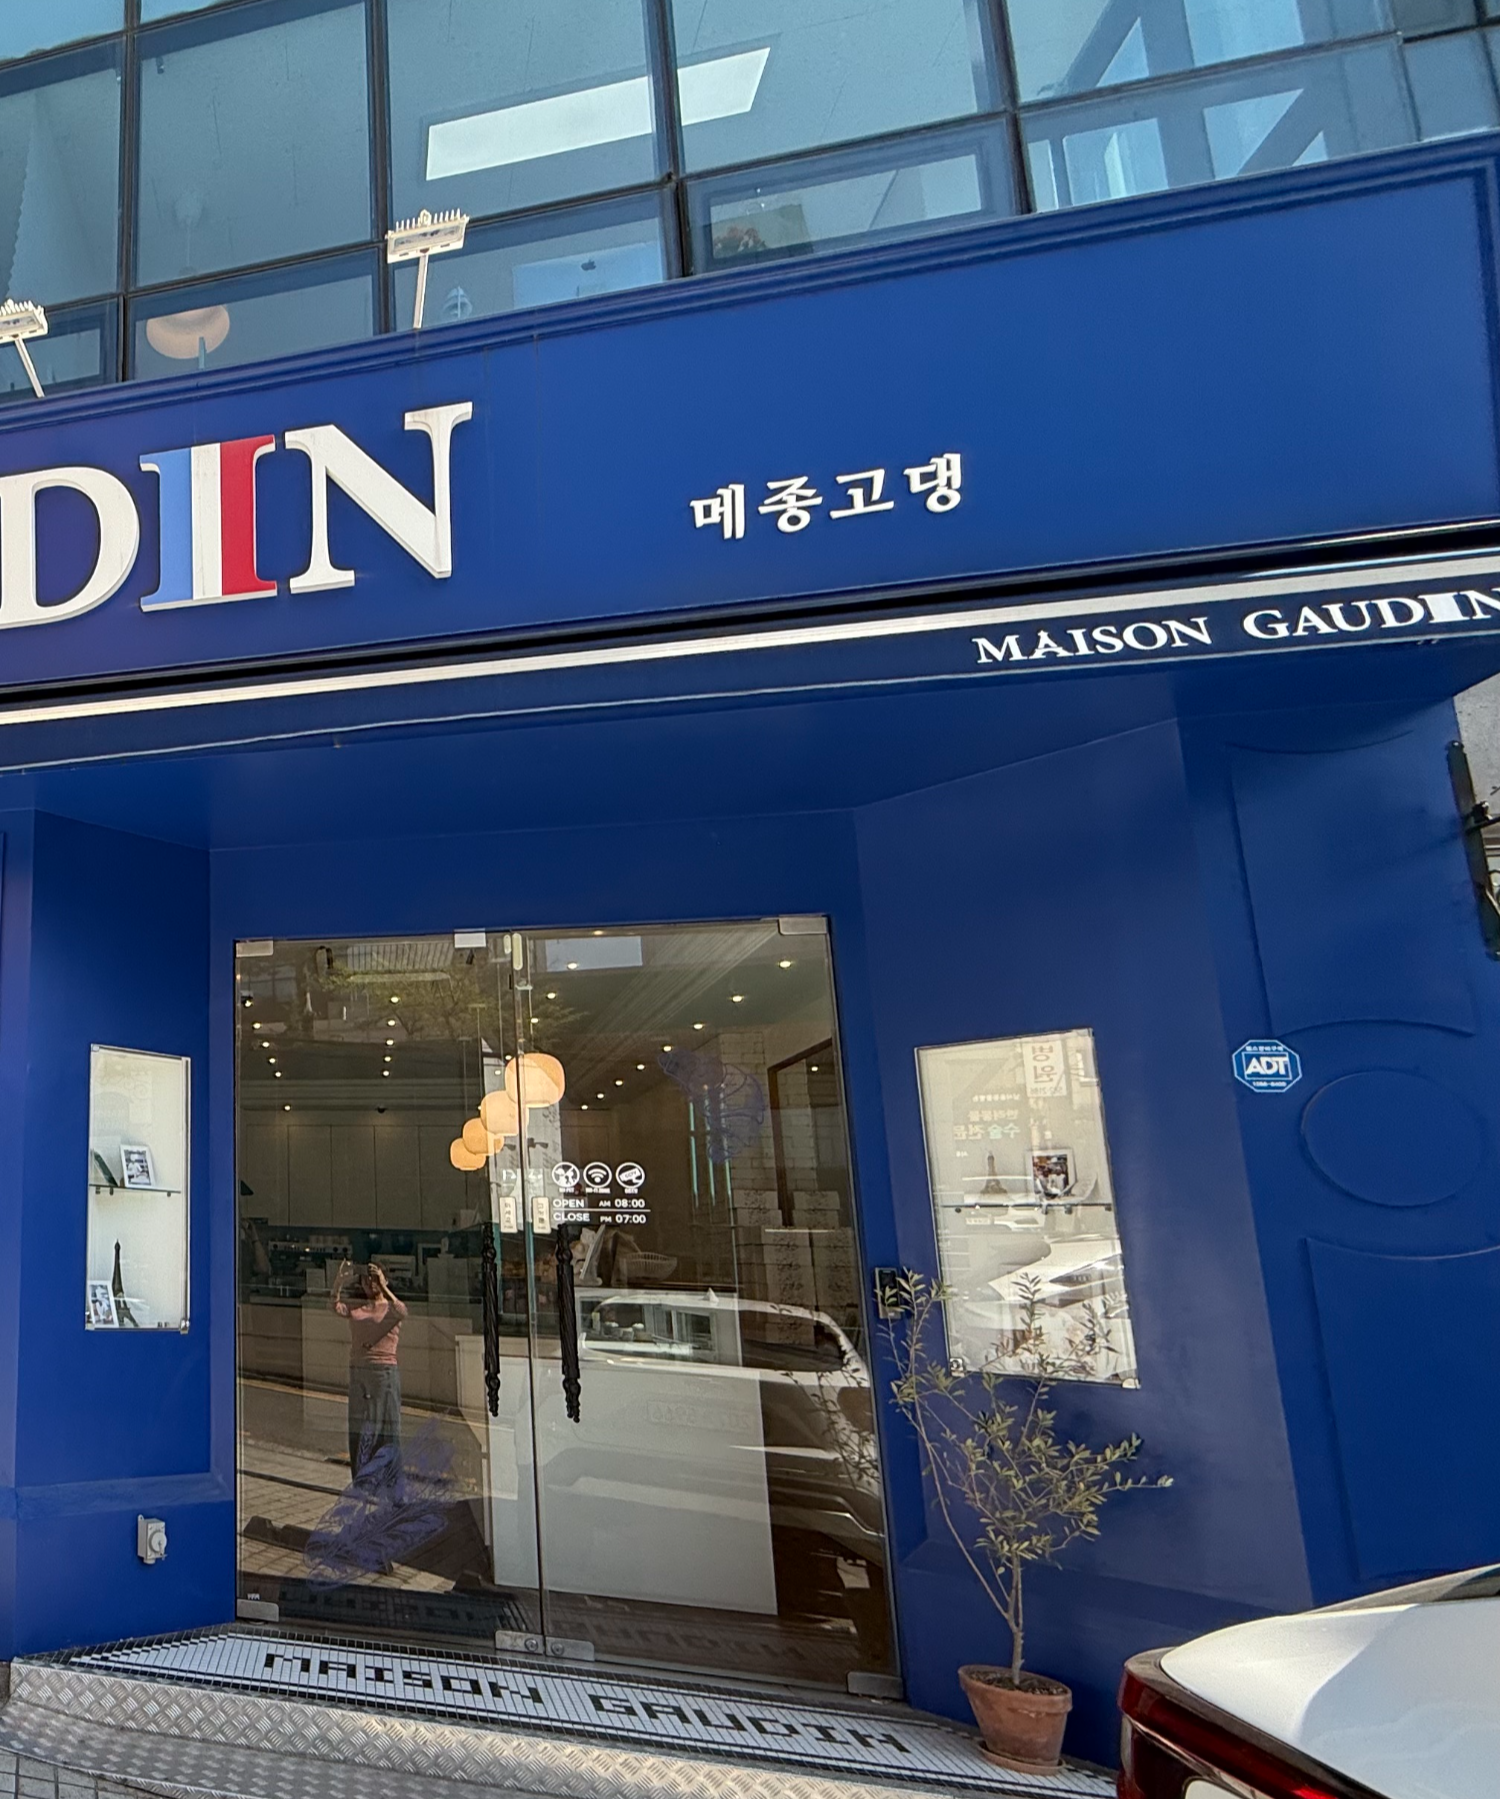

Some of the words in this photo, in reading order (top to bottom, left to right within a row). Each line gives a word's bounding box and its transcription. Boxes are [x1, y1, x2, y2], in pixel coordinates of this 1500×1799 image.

[689, 452, 962, 540] 메종고댕
[971, 616, 1213, 665] MAISON
[1242, 586, 1500, 640] GAUDIN
[1245, 1056, 1289, 1075] ADT
[553, 1198, 585, 1208] OPEN
[598, 1200, 611, 1208] AM
[614, 1198, 646, 1209] 08:00
[553, 1212, 591, 1222] CLOSE
[599, 1215, 612, 1223] PM
[615, 1213, 647, 1224] 07:00
[264, 1653, 544, 1704] MAISON
